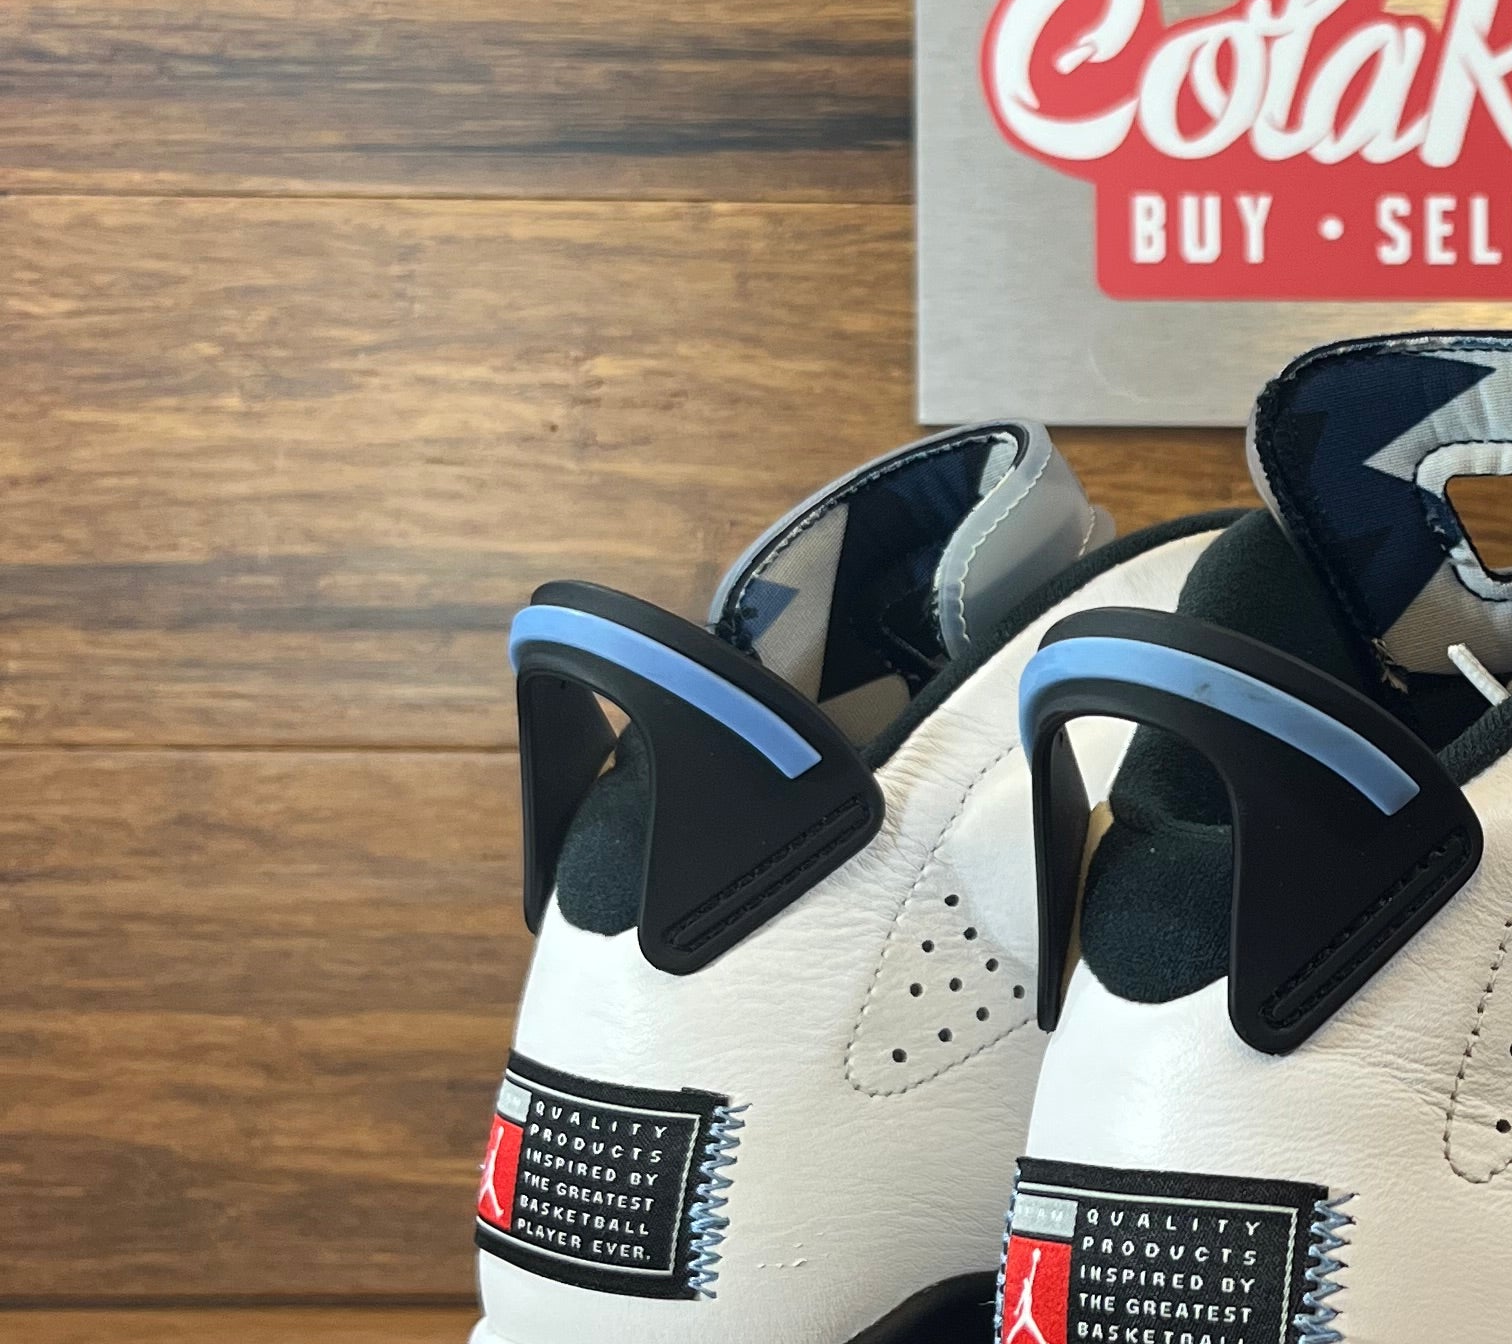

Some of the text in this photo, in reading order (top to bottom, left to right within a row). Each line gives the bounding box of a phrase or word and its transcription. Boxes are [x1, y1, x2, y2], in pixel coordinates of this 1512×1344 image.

[1130, 195, 1272, 265] BUY
[534, 1100, 668, 1139] QUALITY
[529, 1123, 663, 1164] PRODUCTS
[526, 1147, 659, 1187] INSPIRED BY
[523, 1170, 655, 1212] THE GREATEST
[519, 1195, 650, 1236] BASKETBALL
[1086, 1208, 1262, 1236] QUALITY
[517, 1218, 651, 1260] PLAYER EVER.
[1081, 1236, 1257, 1266] PRODUCTS
[1080, 1265, 1204, 1291] INSPIRED
[1079, 1293, 1253, 1324] THE GREATEST
